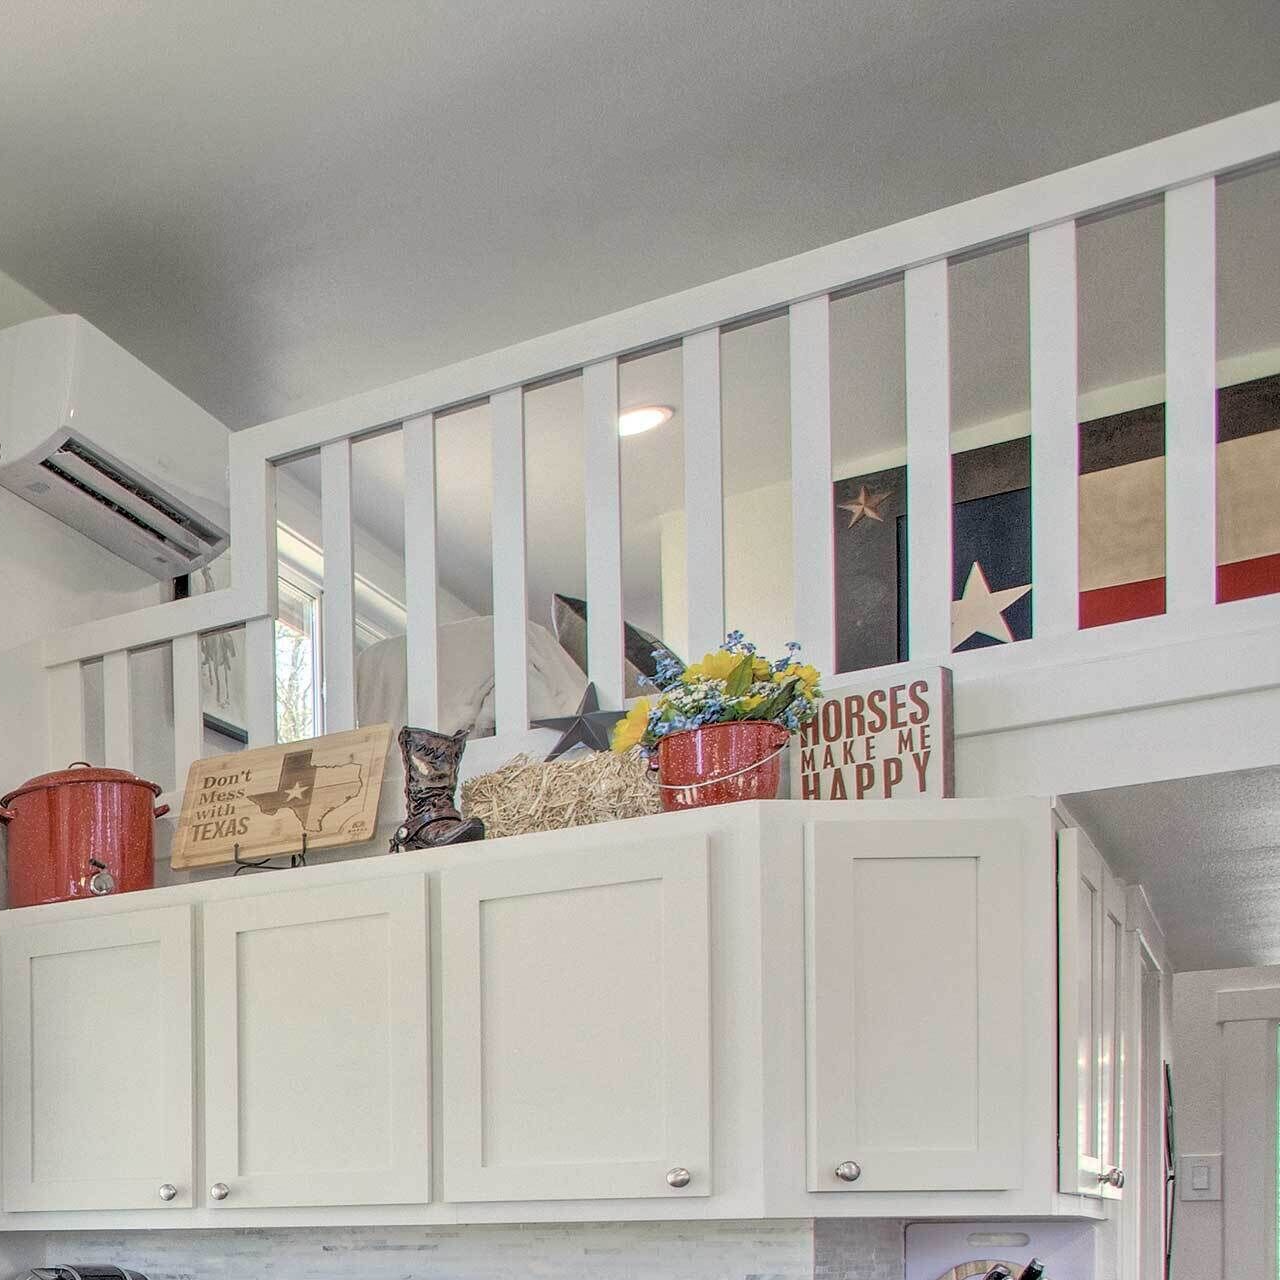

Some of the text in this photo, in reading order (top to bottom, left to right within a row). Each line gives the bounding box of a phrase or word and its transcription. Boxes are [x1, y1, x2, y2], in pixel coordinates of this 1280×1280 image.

[800, 680, 930, 749] HORSES
[801, 723, 931, 774] MAKE ME
[202, 767, 253, 791] Don't
[801, 750, 932, 800] HAPPY
[198, 788, 246, 807] Mess
[194, 803, 237, 821] with
[191, 816, 251, 843] TEXAS
